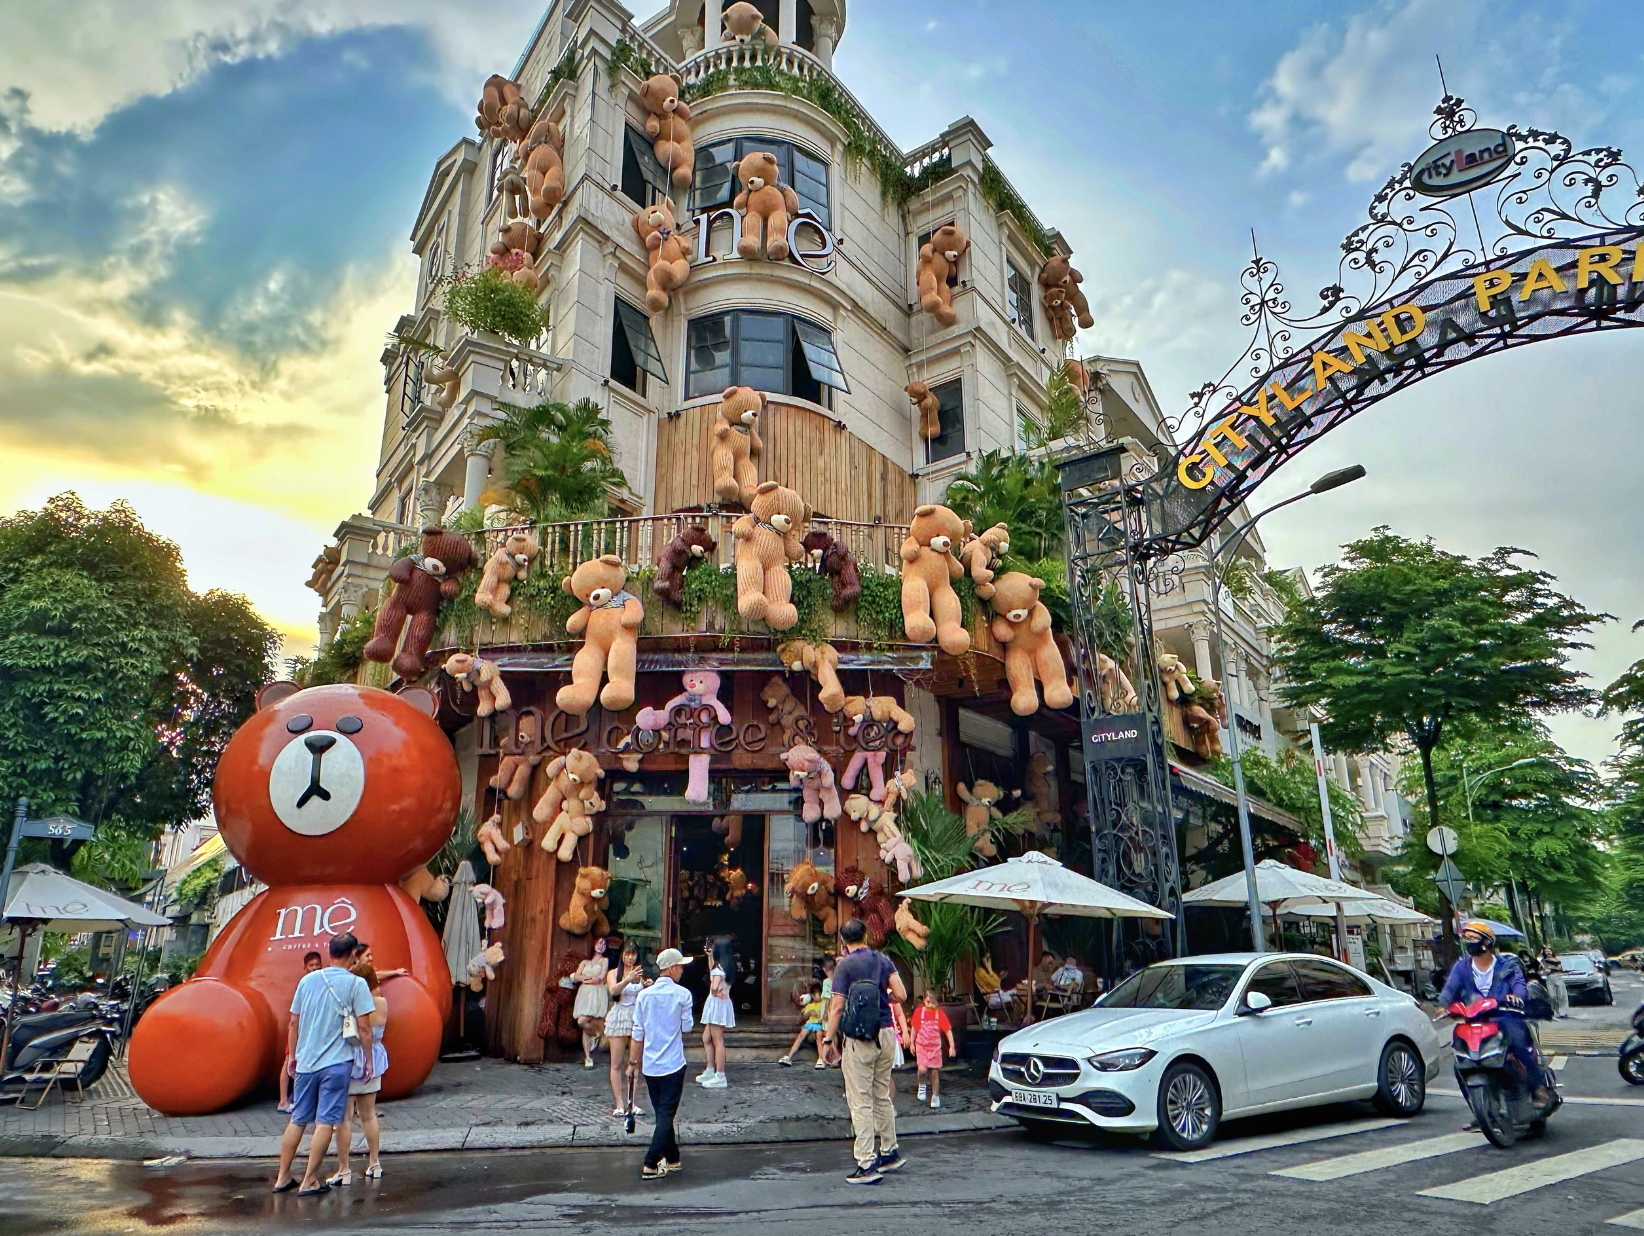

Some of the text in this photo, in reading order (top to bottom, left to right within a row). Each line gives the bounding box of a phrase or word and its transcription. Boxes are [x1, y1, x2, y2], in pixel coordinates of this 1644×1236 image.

[1178, 304, 1427, 491] CITYLAND
[603, 704, 767, 755] coffee
[786, 715, 823, 752] &
[833, 712, 917, 752] tea
[1091, 729, 1138, 743] CITYLAND
[269, 897, 358, 941] mê
